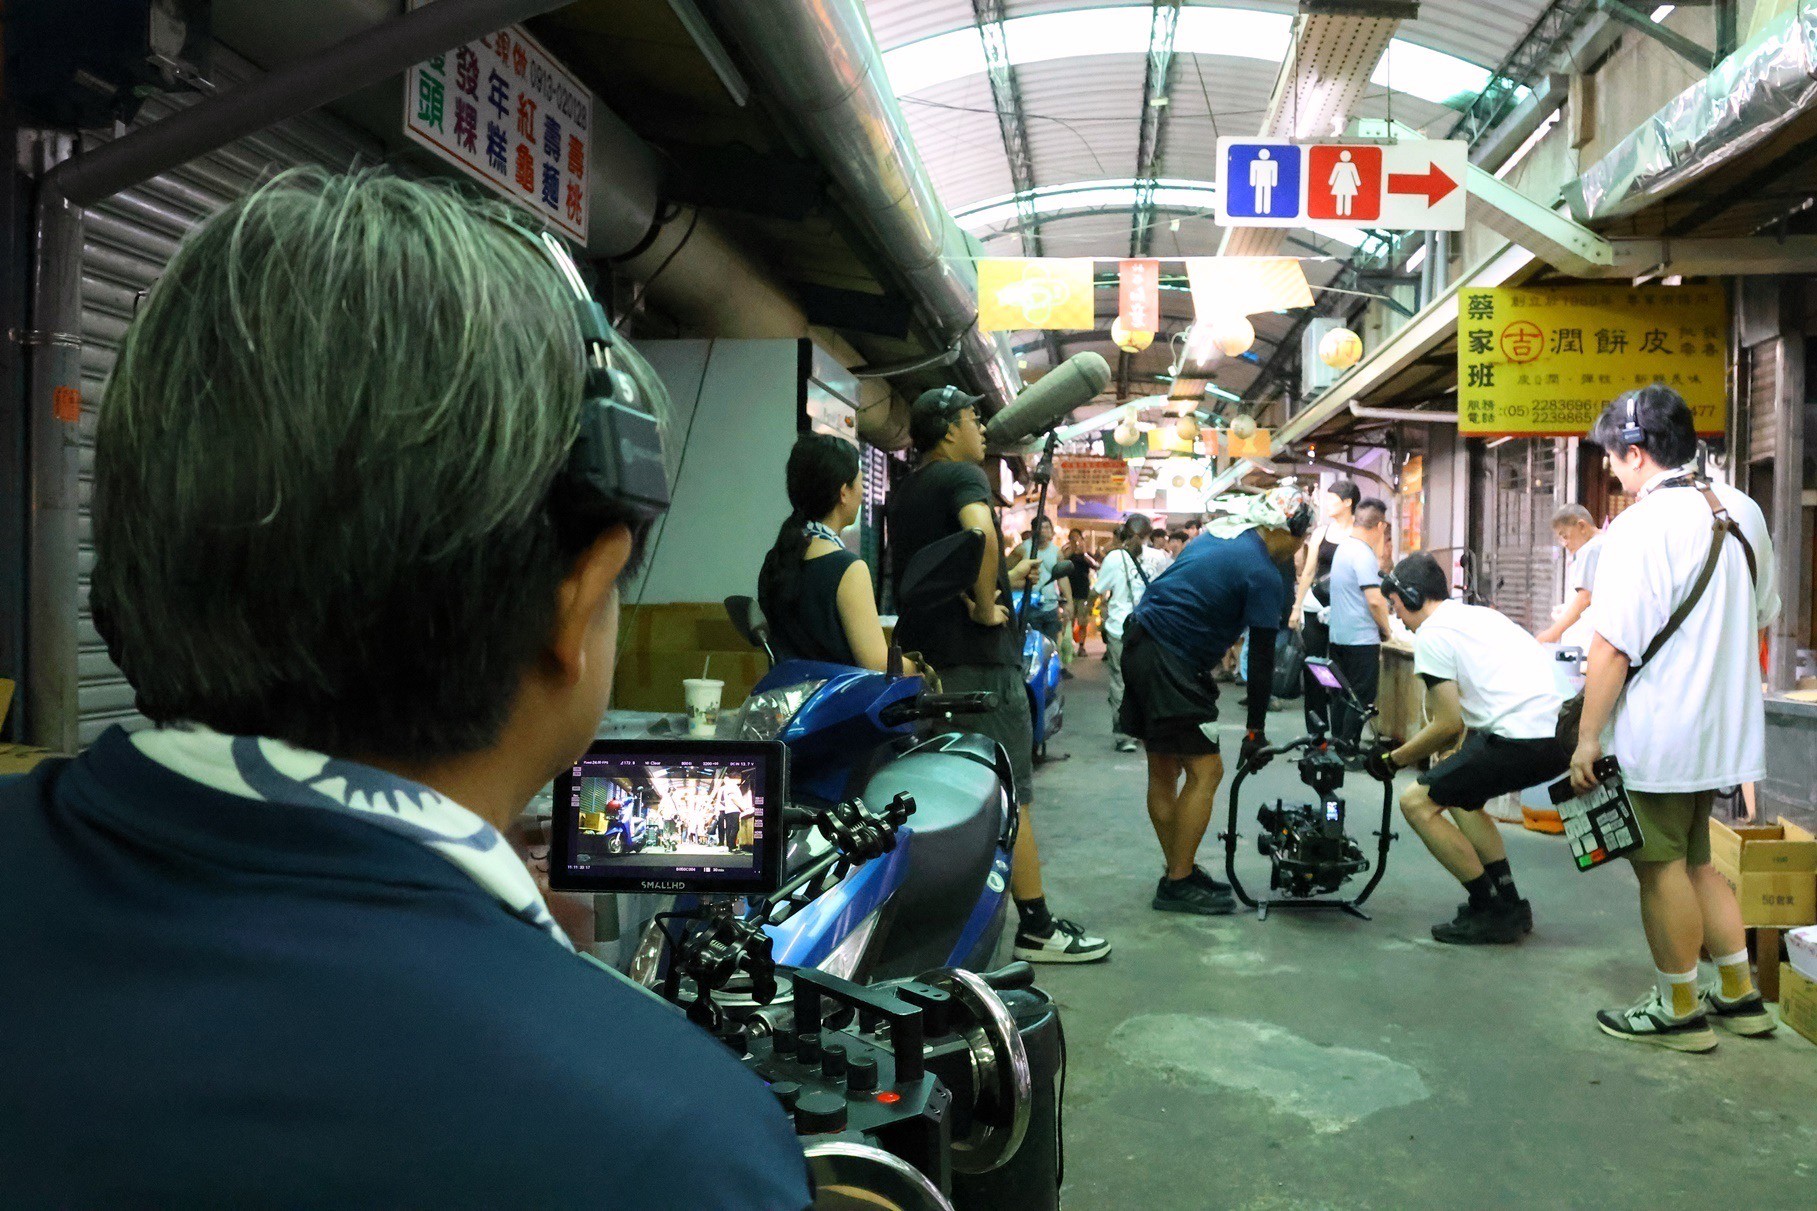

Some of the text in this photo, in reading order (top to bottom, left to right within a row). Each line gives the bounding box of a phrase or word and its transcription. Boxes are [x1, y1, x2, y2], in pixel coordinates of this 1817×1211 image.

[486, 68, 510, 176] 年糕
[514, 92, 537, 193] 紅龜
[565, 133, 584, 226] 壽桃
[1467, 293, 1495, 388] 蔡家班
[1502, 324, 1674, 359] 吉 潤餅皮
[641, 881, 686, 890] SMALLHD
